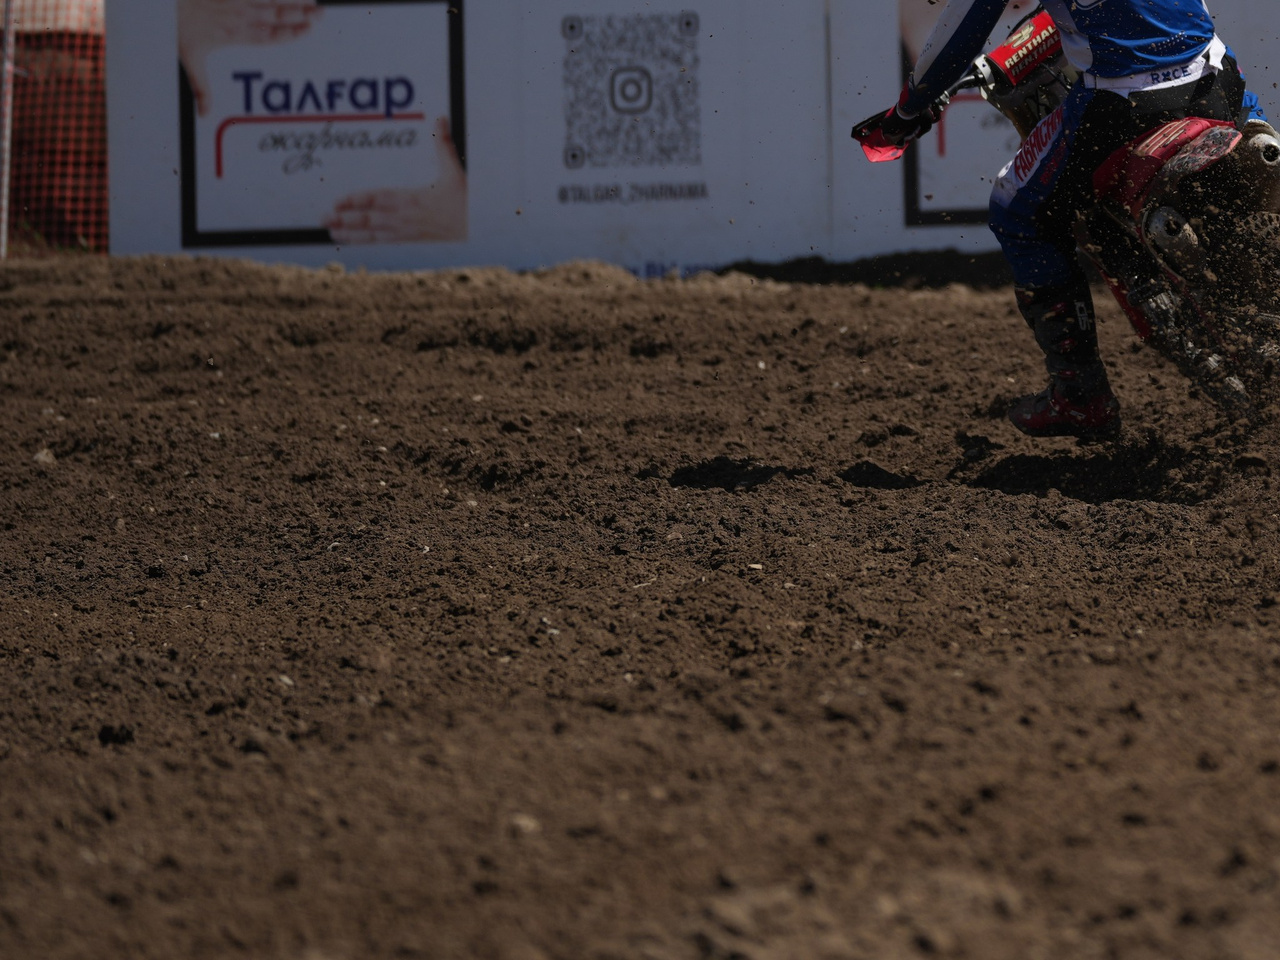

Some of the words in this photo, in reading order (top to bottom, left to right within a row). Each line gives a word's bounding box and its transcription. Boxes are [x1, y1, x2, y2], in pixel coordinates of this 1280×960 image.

[1004, 25, 1057, 70] RENTHAL
[1011, 34, 1061, 77] RENTHAL
[232, 71, 415, 119] Талғар
